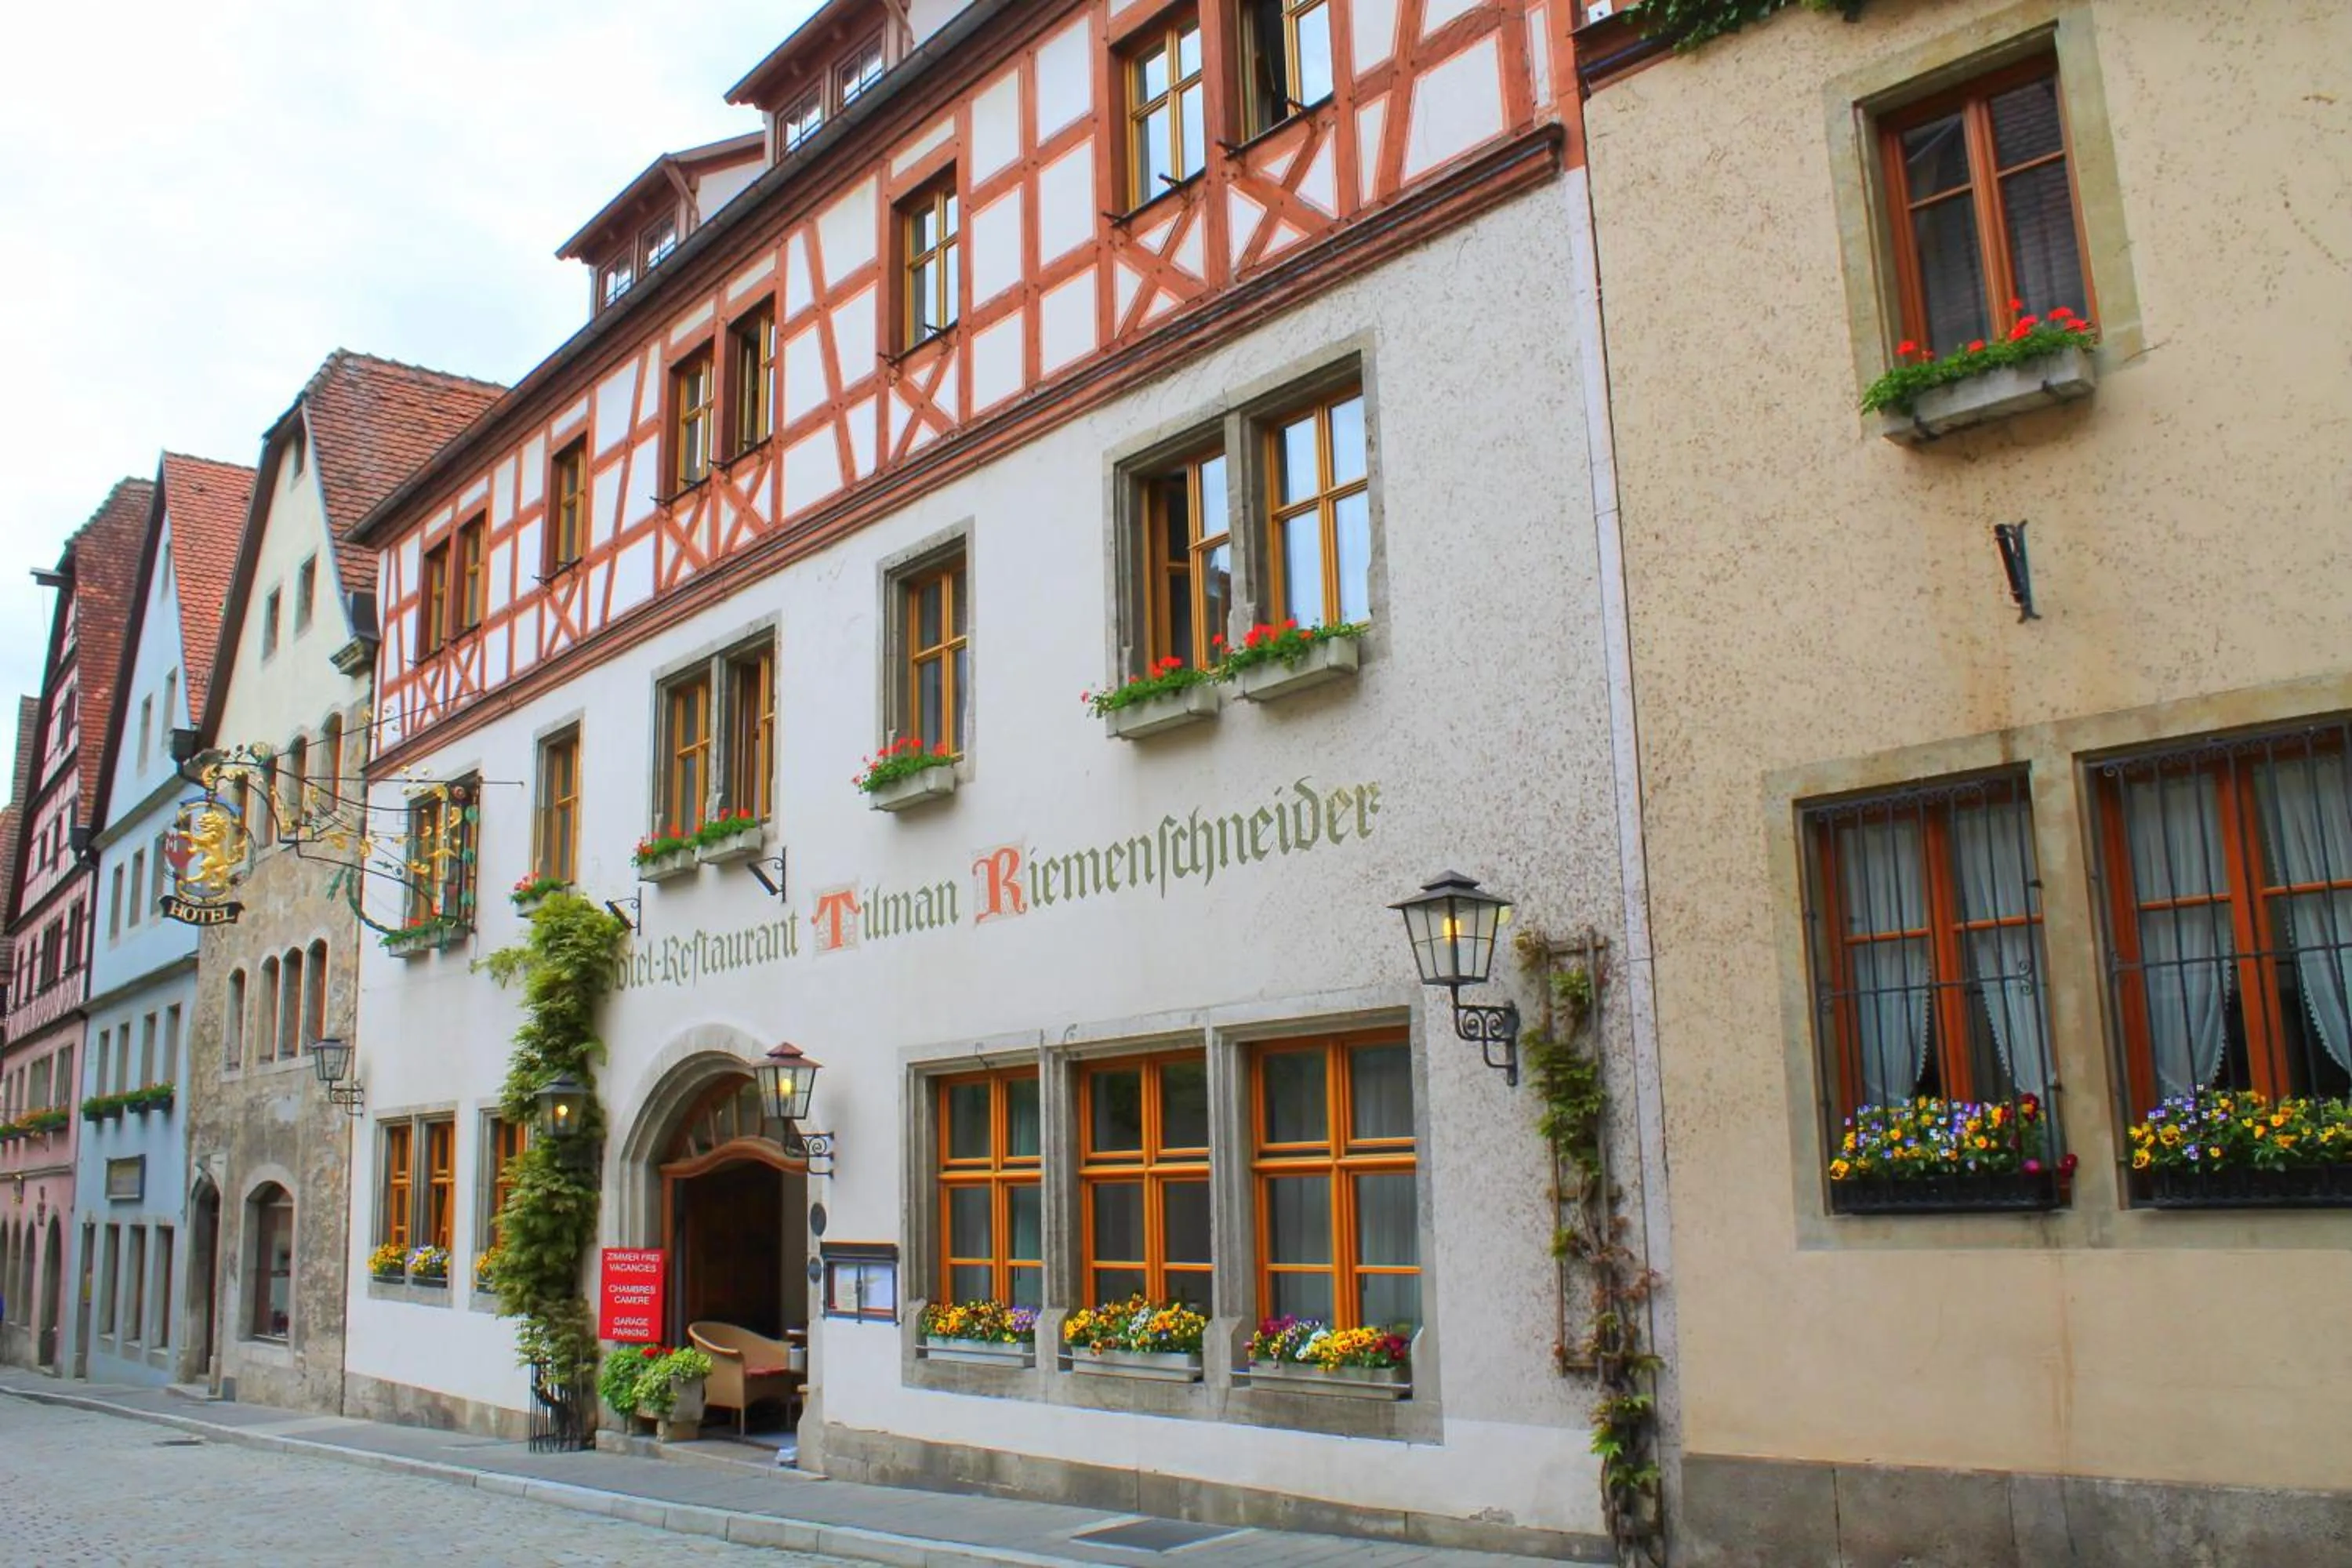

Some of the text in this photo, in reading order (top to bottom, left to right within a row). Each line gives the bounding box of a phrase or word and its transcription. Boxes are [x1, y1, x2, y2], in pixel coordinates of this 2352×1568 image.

[169, 899, 235, 924] HOTEL
[811, 879, 959, 951] Tilman
[606, 1252, 639, 1261] ZIMMER
[609, 1263, 656, 1272] VACANCIES
[608, 1284, 655, 1294] CHAMBRES
[614, 1295, 650, 1305] CAMERE
[613, 1316, 648, 1326] GARAGE
[612, 1327, 649, 1337] PARKING
